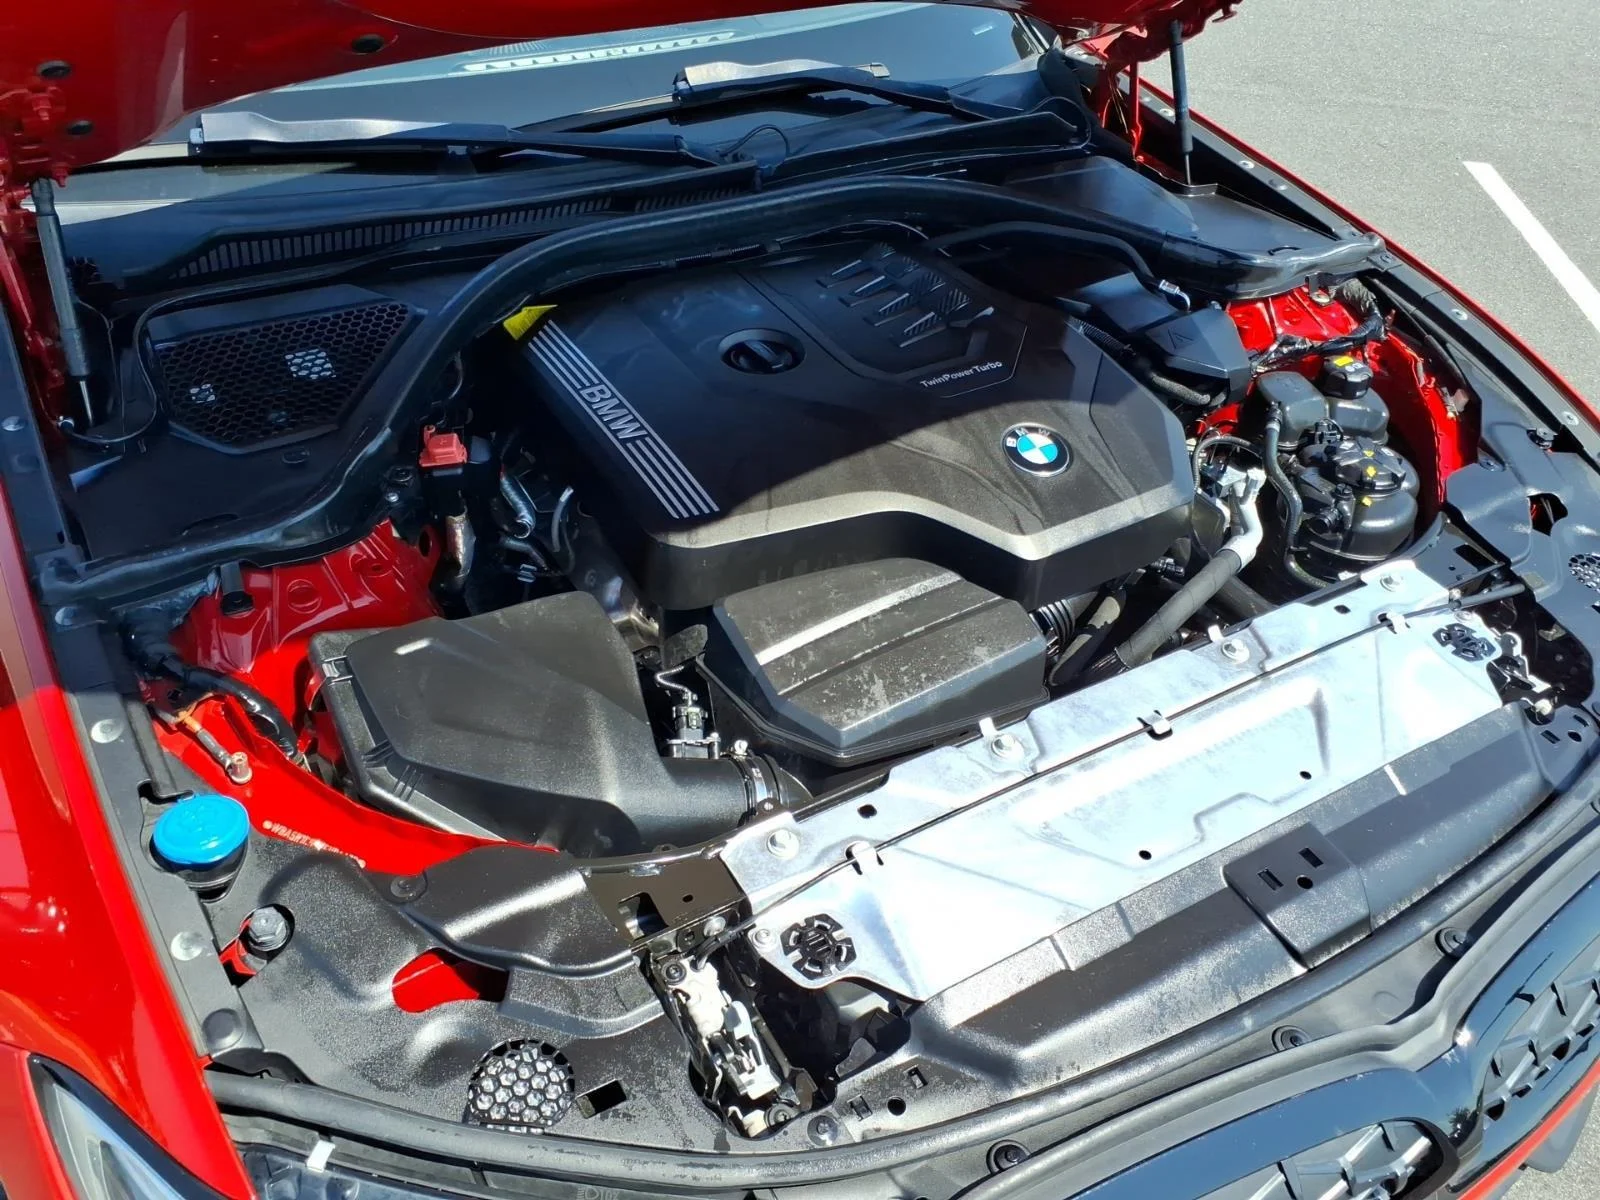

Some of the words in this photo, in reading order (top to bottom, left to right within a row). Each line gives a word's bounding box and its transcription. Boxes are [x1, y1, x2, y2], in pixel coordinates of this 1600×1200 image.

[920, 370, 974, 388] TwinPower
[972, 361, 1003, 373] Turbo
[579, 384, 648, 439] BMW
